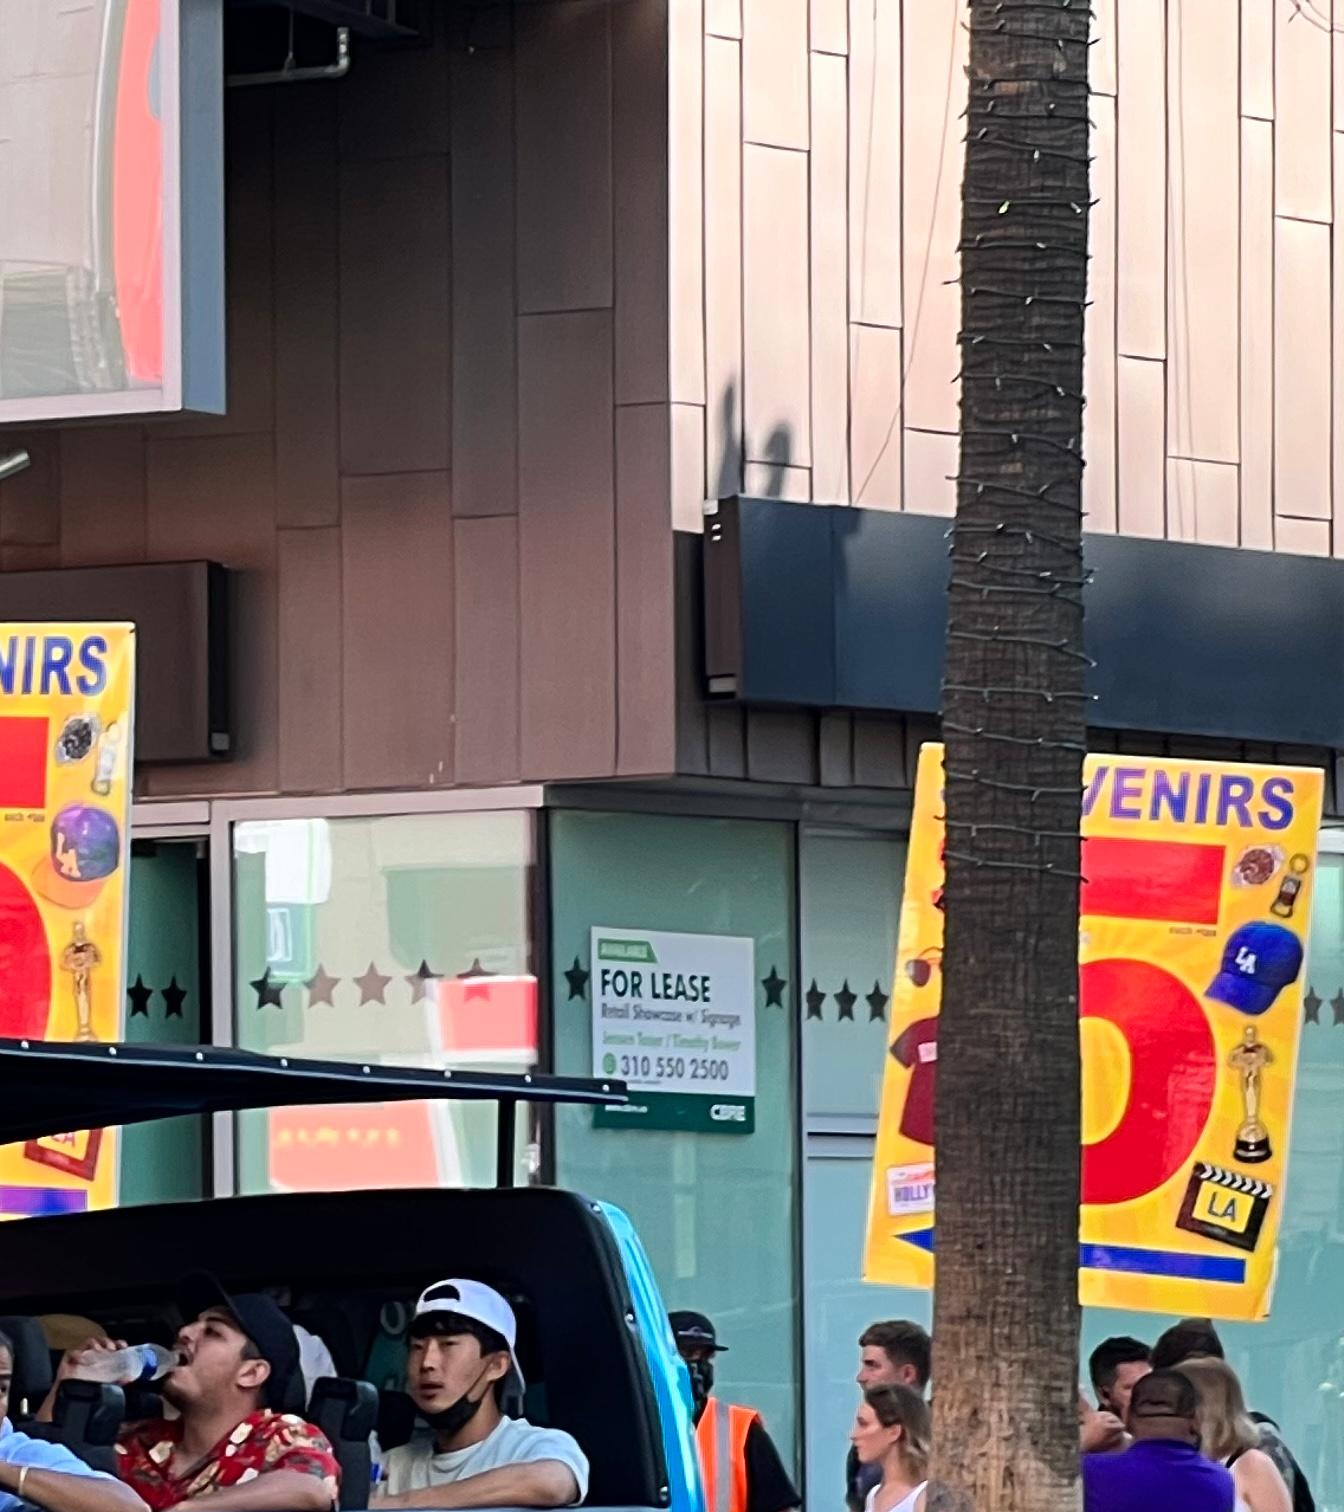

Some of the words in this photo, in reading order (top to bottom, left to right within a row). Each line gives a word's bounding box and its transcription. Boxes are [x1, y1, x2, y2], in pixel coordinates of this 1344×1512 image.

[1235, 946, 1256, 974] LA
[601, 968, 642, 998] FOR
[651, 971, 711, 1003] LEASE
[621, 1055, 651, 1076] 310
[656, 1057, 685, 1078] 550
[690, 1058, 729, 1081] 2500
[1206, 1190, 1237, 1223] LA
